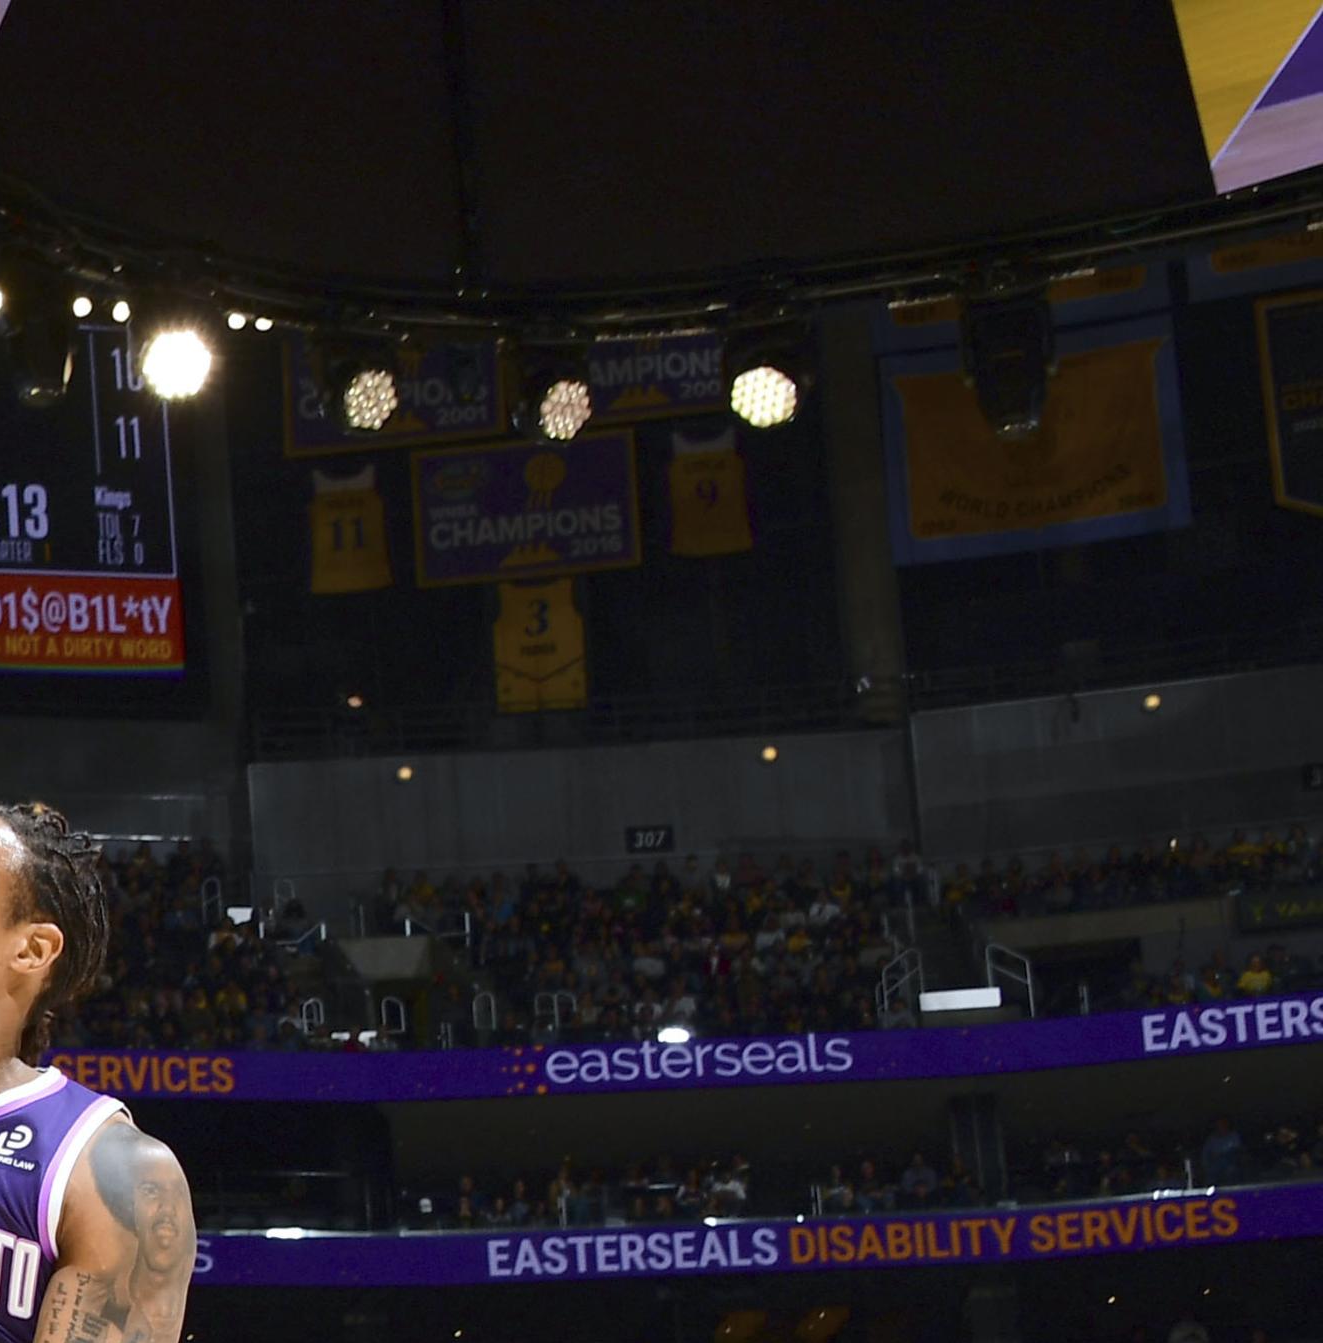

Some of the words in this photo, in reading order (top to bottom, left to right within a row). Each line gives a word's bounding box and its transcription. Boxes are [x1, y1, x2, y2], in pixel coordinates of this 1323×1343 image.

[115, 416, 142, 459] 11
[430, 505, 623, 551] CHAMPIONS
[524, 601, 550, 639] 3
[5, 636, 40, 652] NOT
[63, 640, 115, 657] DIRTY
[120, 641, 172, 660] WORD
[633, 830, 667, 849] 307
[545, 1033, 853, 1086] easterseals
[488, 1227, 777, 1278] EASTERSEALS
[788, 1211, 1022, 1264] DISABILITY
[1029, 1198, 1240, 1253] SERVICES
